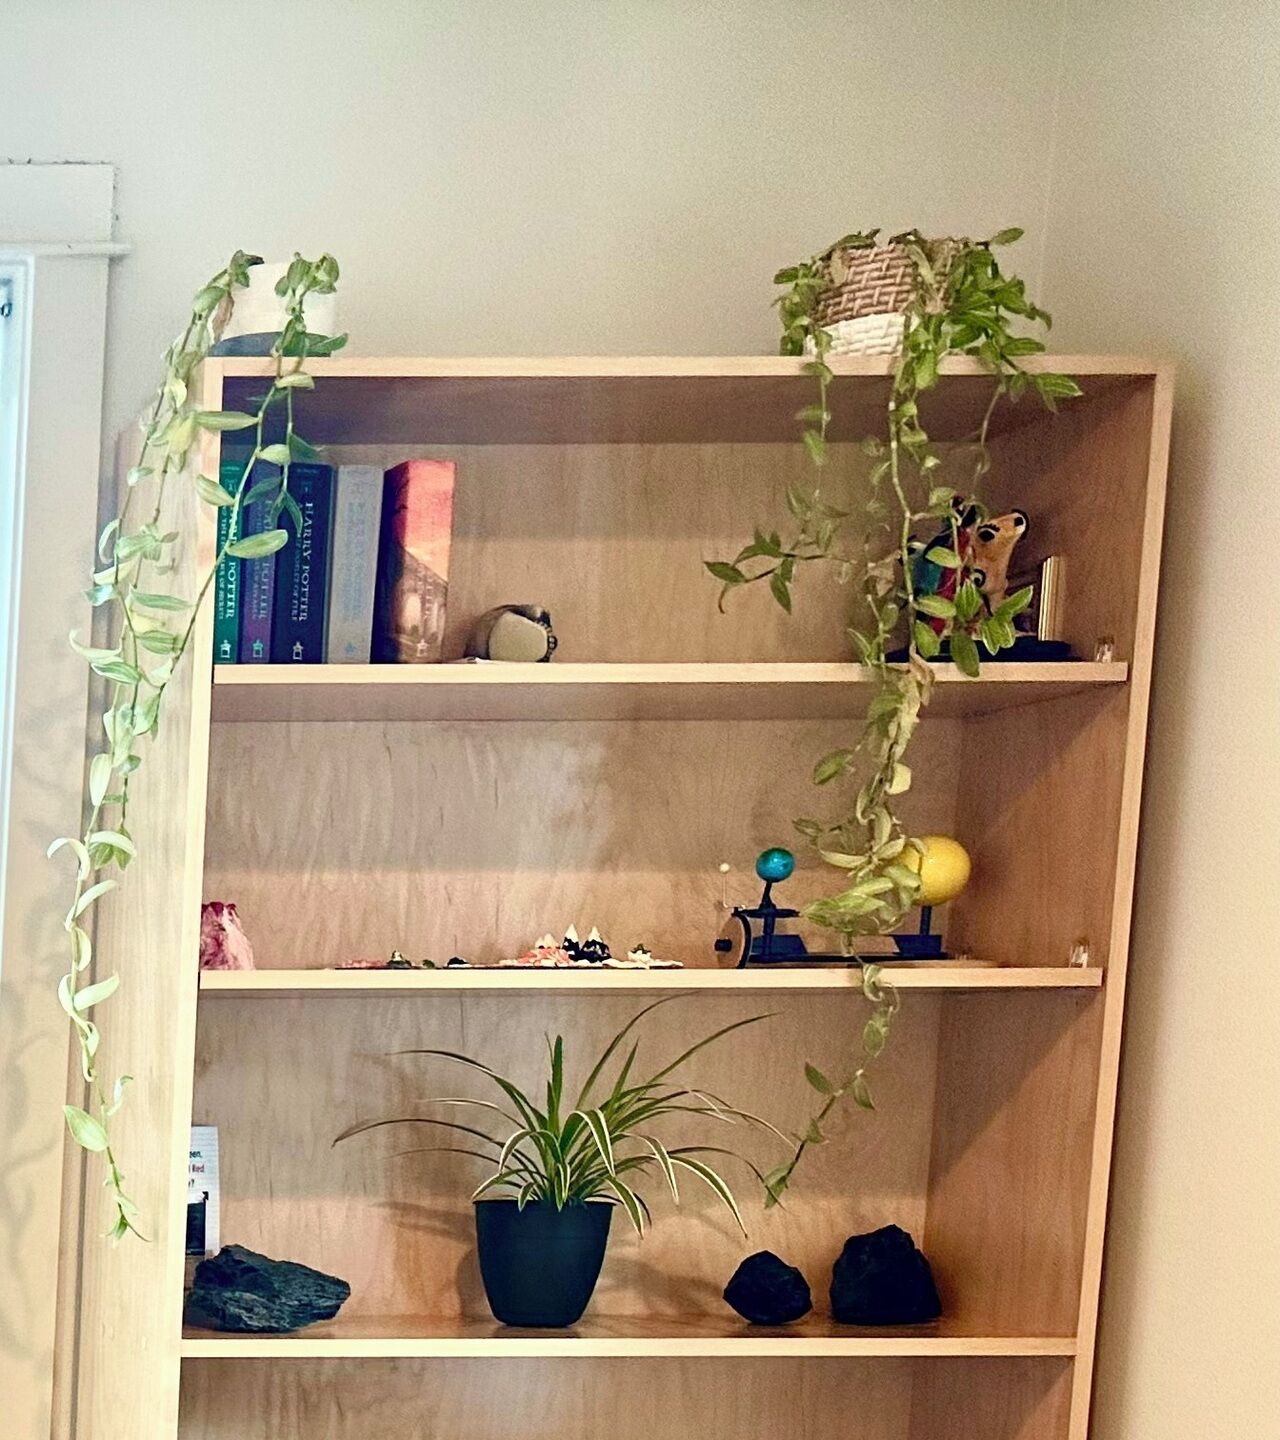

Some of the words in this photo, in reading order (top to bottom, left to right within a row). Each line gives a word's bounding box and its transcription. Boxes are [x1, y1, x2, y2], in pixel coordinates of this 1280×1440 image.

[302, 501, 313, 561] HARRY
[226, 562, 236, 618] POTTER
[299, 565, 309, 621] POTTER
